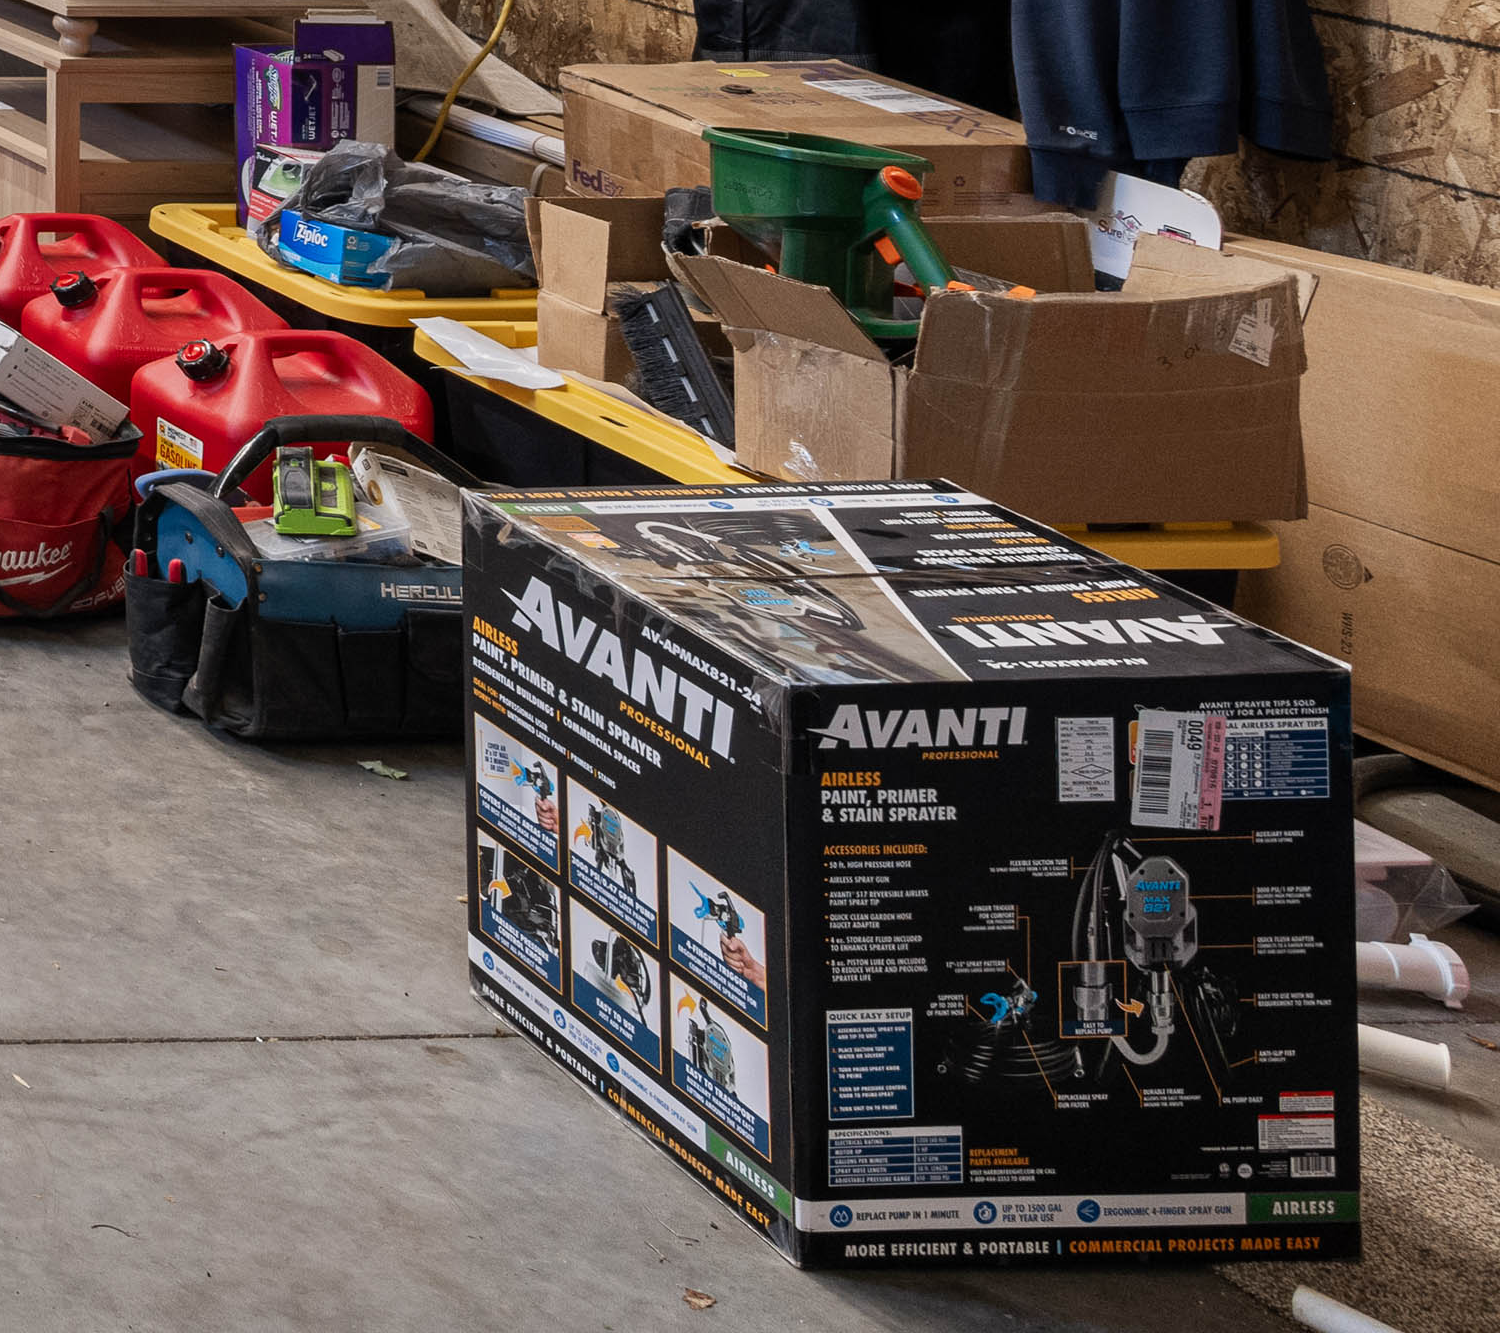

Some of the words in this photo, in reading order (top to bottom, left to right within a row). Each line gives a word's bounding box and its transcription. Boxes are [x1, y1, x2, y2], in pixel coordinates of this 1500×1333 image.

[572, 161, 624, 197] FedEx
[296, 223, 328, 248] Ziploc
[909, 587, 975, 598] SPRAYER
[1071, 588, 1160, 603] AIRLESS
[952, 614, 1054, 623] PROFESSIONAL
[472, 616, 518, 656] AIRLESS
[940, 614, 1237, 649] AVANTI
[500, 576, 734, 760] AVANTI
[641, 625, 762, 706] AV-APMAX821-24
[472, 633, 508, 670] PAINT,
[511, 657, 555, 698] PRIMER
[571, 697, 604, 730] STAIN
[607, 720, 662, 769] SPRAYER
[1235, 700, 1271, 709] SPRAYER
[1273, 700, 1291, 708] TIPS
[1293, 699, 1316, 707] SOLD
[1240, 708, 1255, 717] FOR
[1265, 707, 1299, 716] PERFECT
[1301, 706, 1329, 715] FINISH
[516, 684, 554, 717] BUILDINGS
[563, 717, 612, 756] COMMERCIAL
[614, 747, 641, 775] SPACES
[805, 704, 1027, 749] AVANTI
[1241, 721, 1276, 729] AIRLESS
[1278, 720, 1303, 728] SPRAY
[1306, 720, 1324, 728] TIPS
[619, 701, 711, 769] PROFESSIONAL
[922, 750, 999, 760] PROFESSIONAL
[821, 772, 881, 787] AIRLESS
[821, 790, 872, 807] PAINT,
[877, 788, 938, 804] PRIMER
[821, 808, 834, 823] &
[840, 808, 883, 822] STAIN
[889, 806, 957, 822] SPRAYER
[824, 845, 881, 856] ACCESSORIES
[883, 844, 928, 855] INCLUDED:
[1134, 879, 1181, 892] AVANTI
[1143, 902, 1171, 914] 821
[829, 1013, 859, 1021] QUICK
[860, 1012, 883, 1020] EASY
[885, 1011, 911, 1019] SETUP
[506, 999, 544, 1041] EFFICIENT
[555, 1044, 597, 1086] PORTABLE
[607, 1089, 666, 1143] COMMERCIAL
[669, 1136, 712, 1182] PROJECTS
[715, 1176, 743, 1208] MADE
[746, 1201, 770, 1228] EASY
[725, 1151, 775, 1199] AIRLESS
[1002, 1204, 1012, 1213] UP
[1014, 1204, 1025, 1213] TO
[1028, 1203, 1046, 1213] 1500
[1048, 1203, 1062, 1212] GAL
[1103, 1207, 1150, 1217] ERGONOMIC
[1152, 1206, 1186, 1216] 4-FINGER
[1188, 1206, 1212, 1215] SPRAY
[1215, 1205, 1231, 1215] GUN
[1272, 1200, 1335, 1215] AIRLESS
[856, 1211, 887, 1221] REPLACE
[889, 1210, 911, 1220] PUMP
[913, 1210, 922, 1219] IN
[931, 1210, 959, 1219] MINUTE
[1002, 1214, 1017, 1223] PER
[1019, 1213, 1038, 1222] YEAR
[1040, 1213, 1054, 1222] USE
[845, 1244, 886, 1257] MORE
[891, 1243, 956, 1256] EFFICIENT
[963, 1242, 973, 1255] &
[979, 1241, 1049, 1255] PORTABLE
[1069, 1240, 1162, 1253] COMMERCIAL
[1168, 1238, 1235, 1252] PROJECTS
[1241, 1237, 1281, 1251] MADE
[1286, 1237, 1321, 1250] EASY
